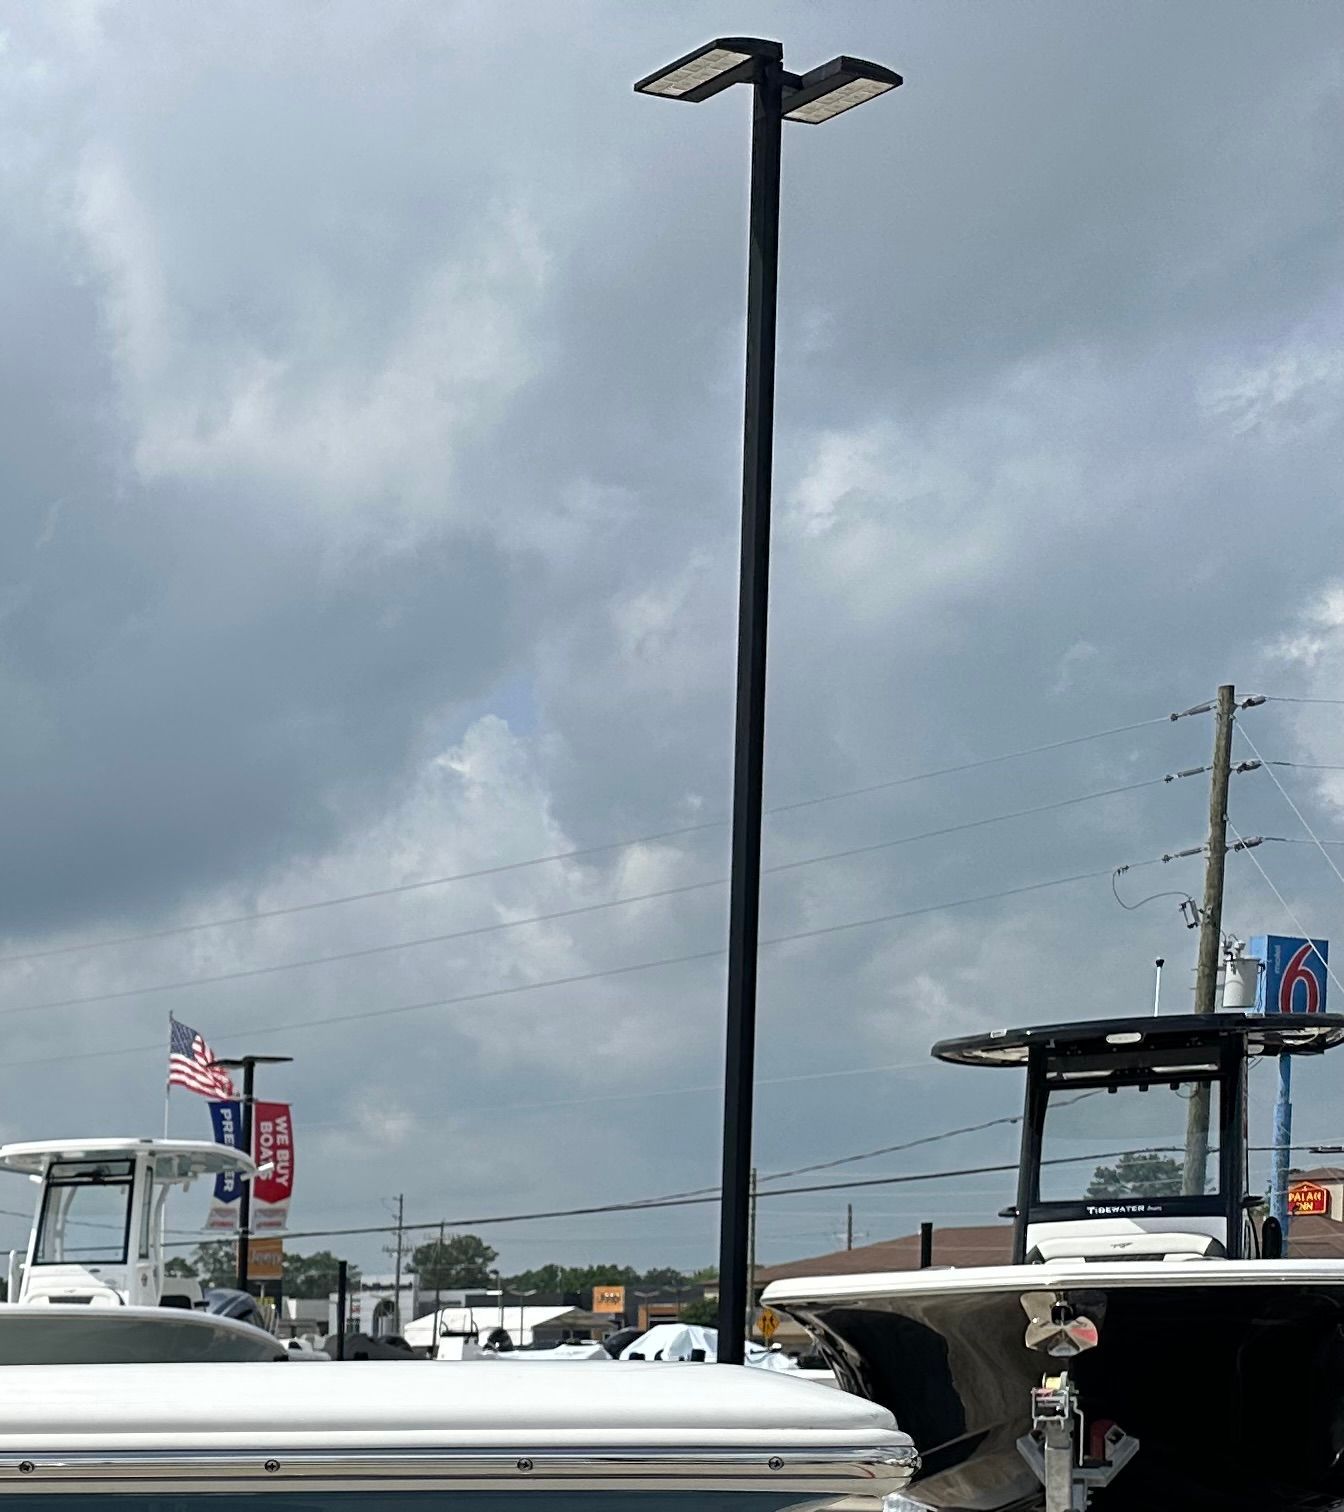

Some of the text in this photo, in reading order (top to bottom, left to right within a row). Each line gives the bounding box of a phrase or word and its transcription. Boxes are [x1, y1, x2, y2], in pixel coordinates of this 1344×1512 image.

[1278, 942, 1320, 1013] 6
[275, 1115, 290, 1188] WE BUY
